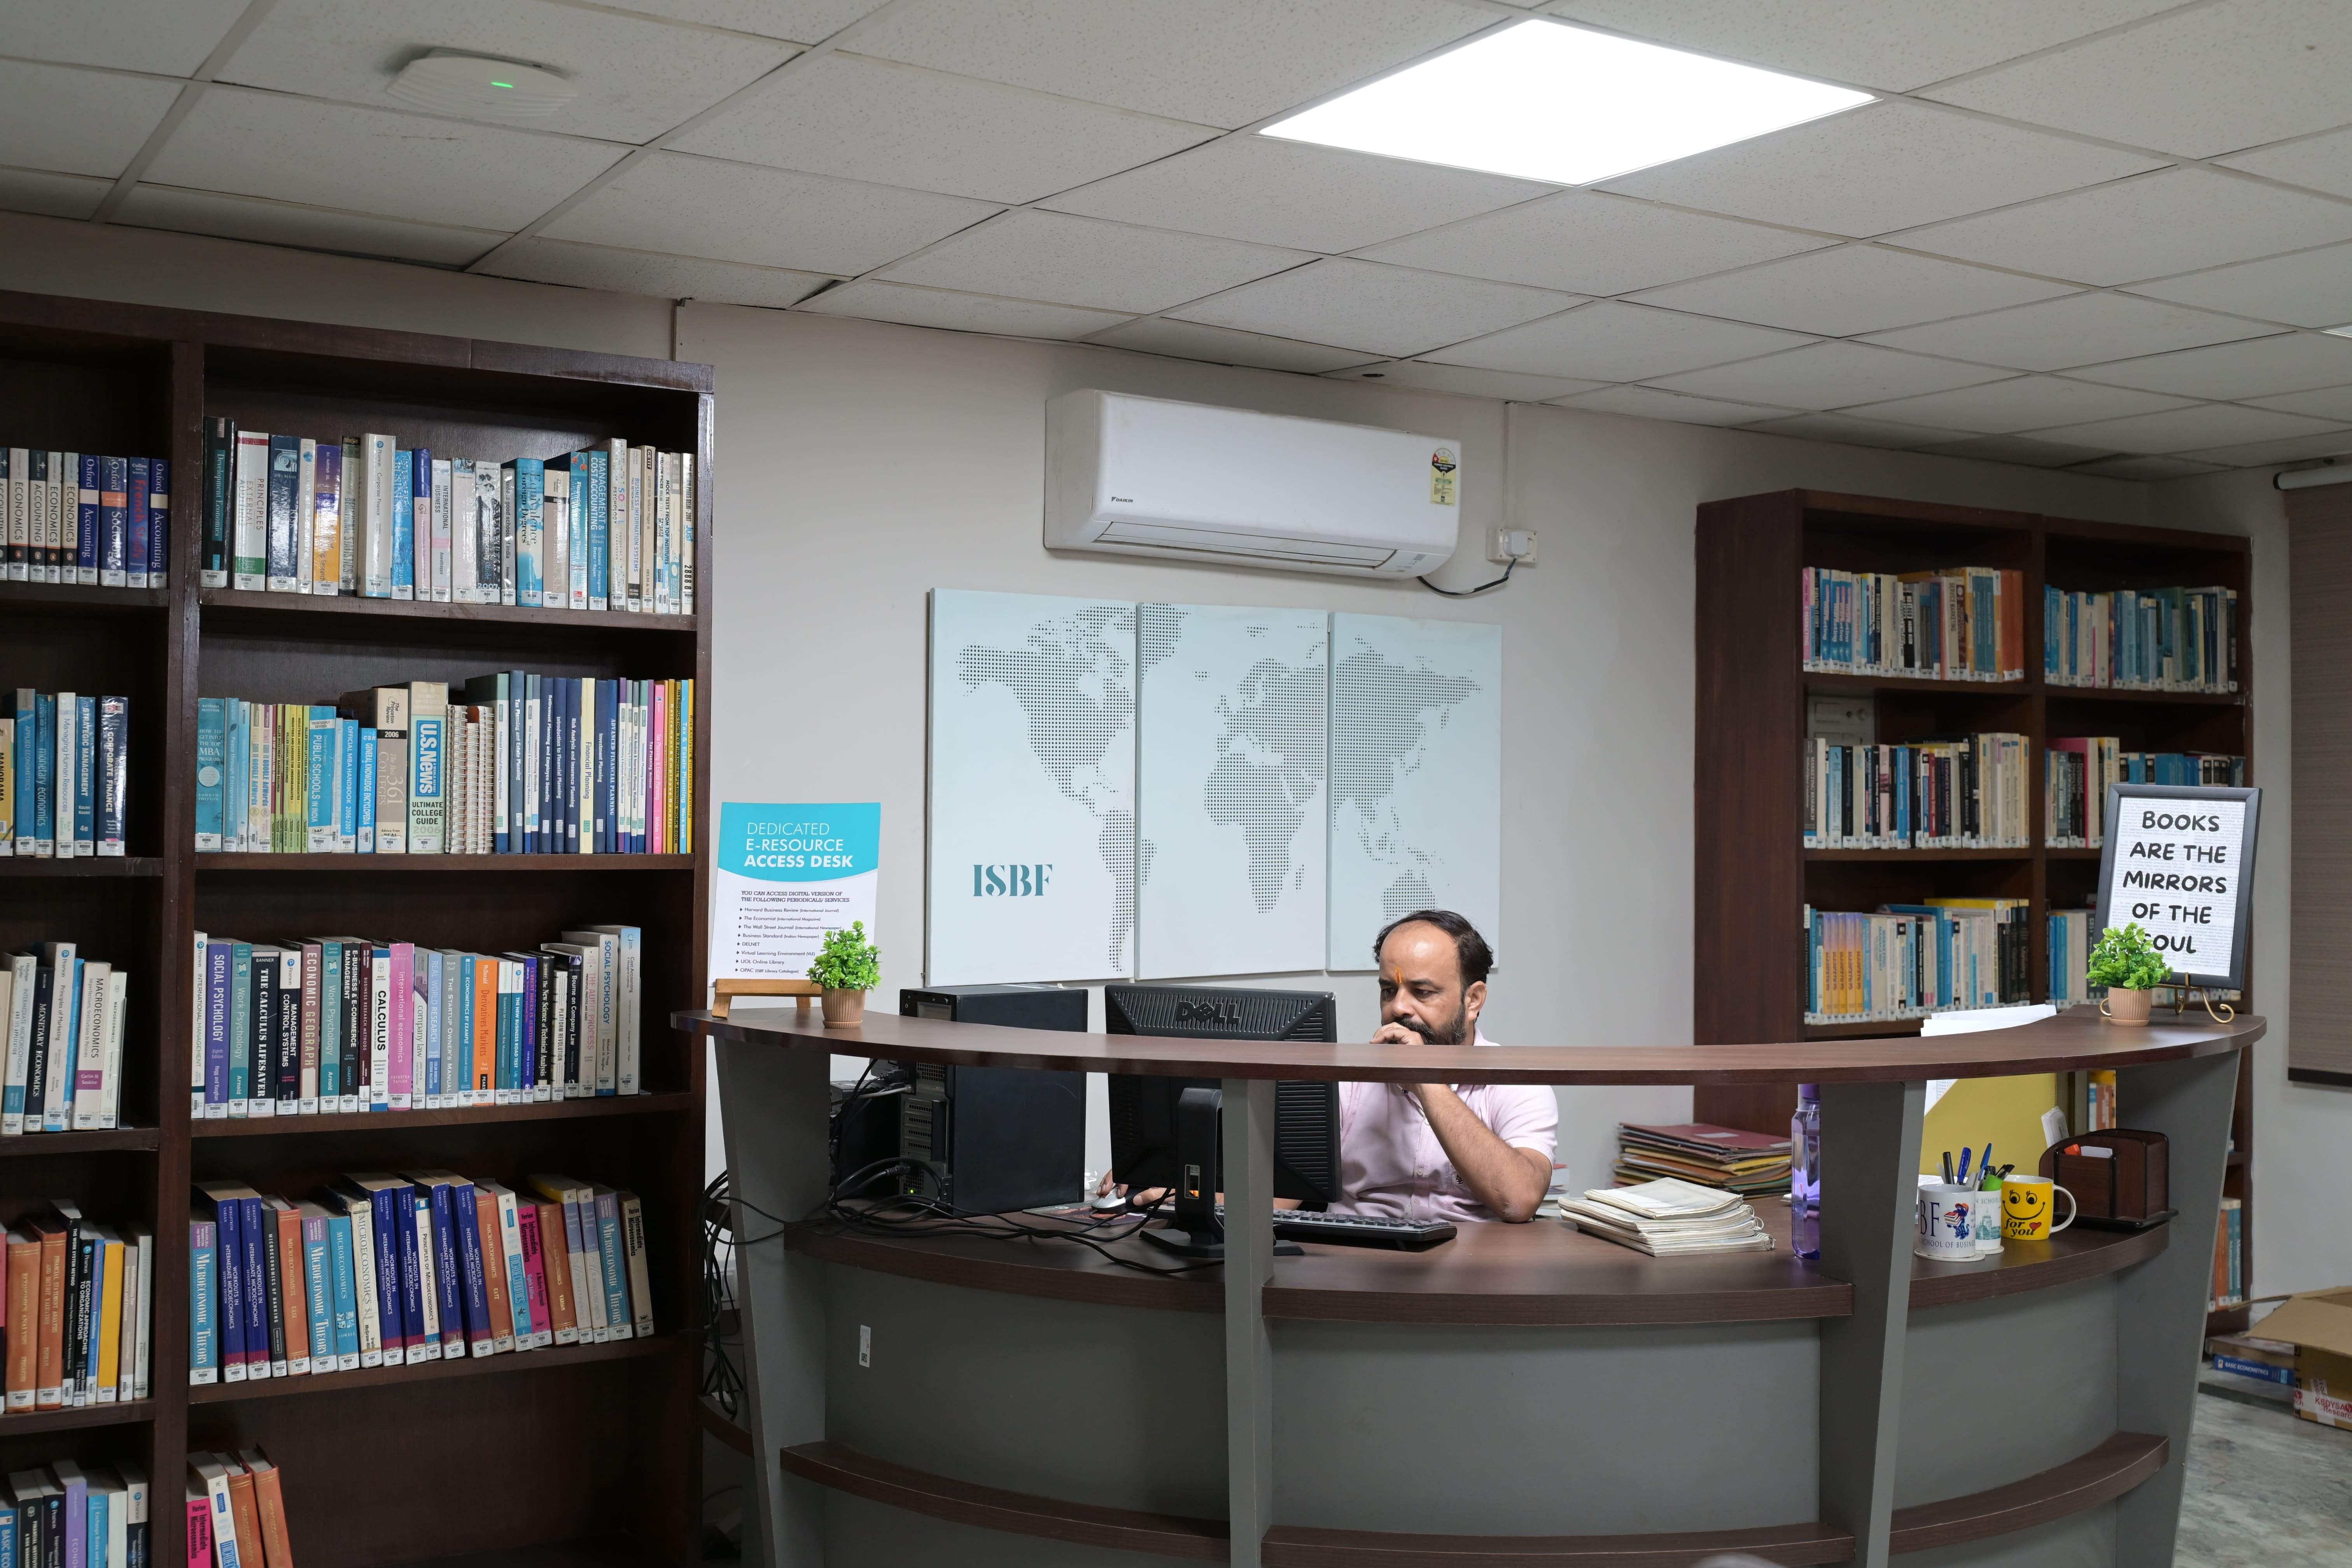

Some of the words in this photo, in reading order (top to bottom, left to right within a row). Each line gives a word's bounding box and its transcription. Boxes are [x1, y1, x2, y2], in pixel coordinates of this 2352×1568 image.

[86, 459, 95, 487] Oxford
[214, 454, 224, 498] Development
[520, 473, 529, 505] Foreign
[598, 458, 606, 523] MANAGEMENT
[15, 482, 23, 540] ECONOMICS
[34, 484, 42, 541] ACCOUNTING
[134, 479, 147, 522] French
[214, 500, 223, 536] Economics
[527, 474, 540, 544] Equivalence
[82, 508, 93, 558] Accounting
[131, 527, 145, 558] Study
[520, 509, 528, 543] Degrees
[82, 708, 90, 746] STRATEGIC
[35, 748, 47, 784] monetary
[313, 735, 322, 762] PUBLIC
[365, 743, 373, 762] GENERAL
[81, 749, 89, 796] MANAGEMENT
[312, 763, 321, 799] SCHOOLS
[364, 762, 372, 792] KNOWLEDGE
[37, 787, 47, 826] economics
[363, 793, 371, 824] ENCYCLOPEDIA
[2142, 811, 2219, 831] BOOKS
[746, 839, 844, 851] E-RESOURCE
[747, 822, 830, 835] DEDICATED
[744, 855, 805, 867] ACCESS
[810, 855, 853, 867] DESK
[2130, 842, 2175, 860] ARE
[2183, 845, 2226, 863] THE
[973, 864, 1052, 896] ISBF
[2123, 871, 2227, 893] MIRRORS
[2132, 903, 2160, 920] OF
[2168, 905, 2212, 924] THE
[214, 955, 224, 984] SOCIAL
[261, 968, 269, 989] THE
[37, 1003, 47, 1047] MONETARY
[91, 978, 103, 1058] MACROECONOMICS
[212, 988, 224, 1042] PSYCHOLOGY
[259, 991, 268, 1041] CALCULUS
[377, 990, 387, 1051] CALCULUS
[415, 1005, 424, 1041] company
[1175, 1001, 1241, 1024] DELL
[33, 1050, 43, 1097] ECONOMICS
[257, 1044, 266, 1097] LIFESAVER
[628, 1218, 637, 1256] Microeconomics
[635, 1216, 643, 1249] Intermediate
[2004, 1218, 2025, 1229] for
[2011, 1229, 2034, 1237] you
[1922, 1239, 1942, 1248] SCHOOL
[83, 1281, 91, 1314] ECONOMIC
[196, 1254, 210, 1326] MICROECONOMIC
[82, 1315, 90, 1355] APPROACHES
[197, 1328, 211, 1364] THEORY
[2237, 1364, 2269, 1376] ECONOMETRICS
